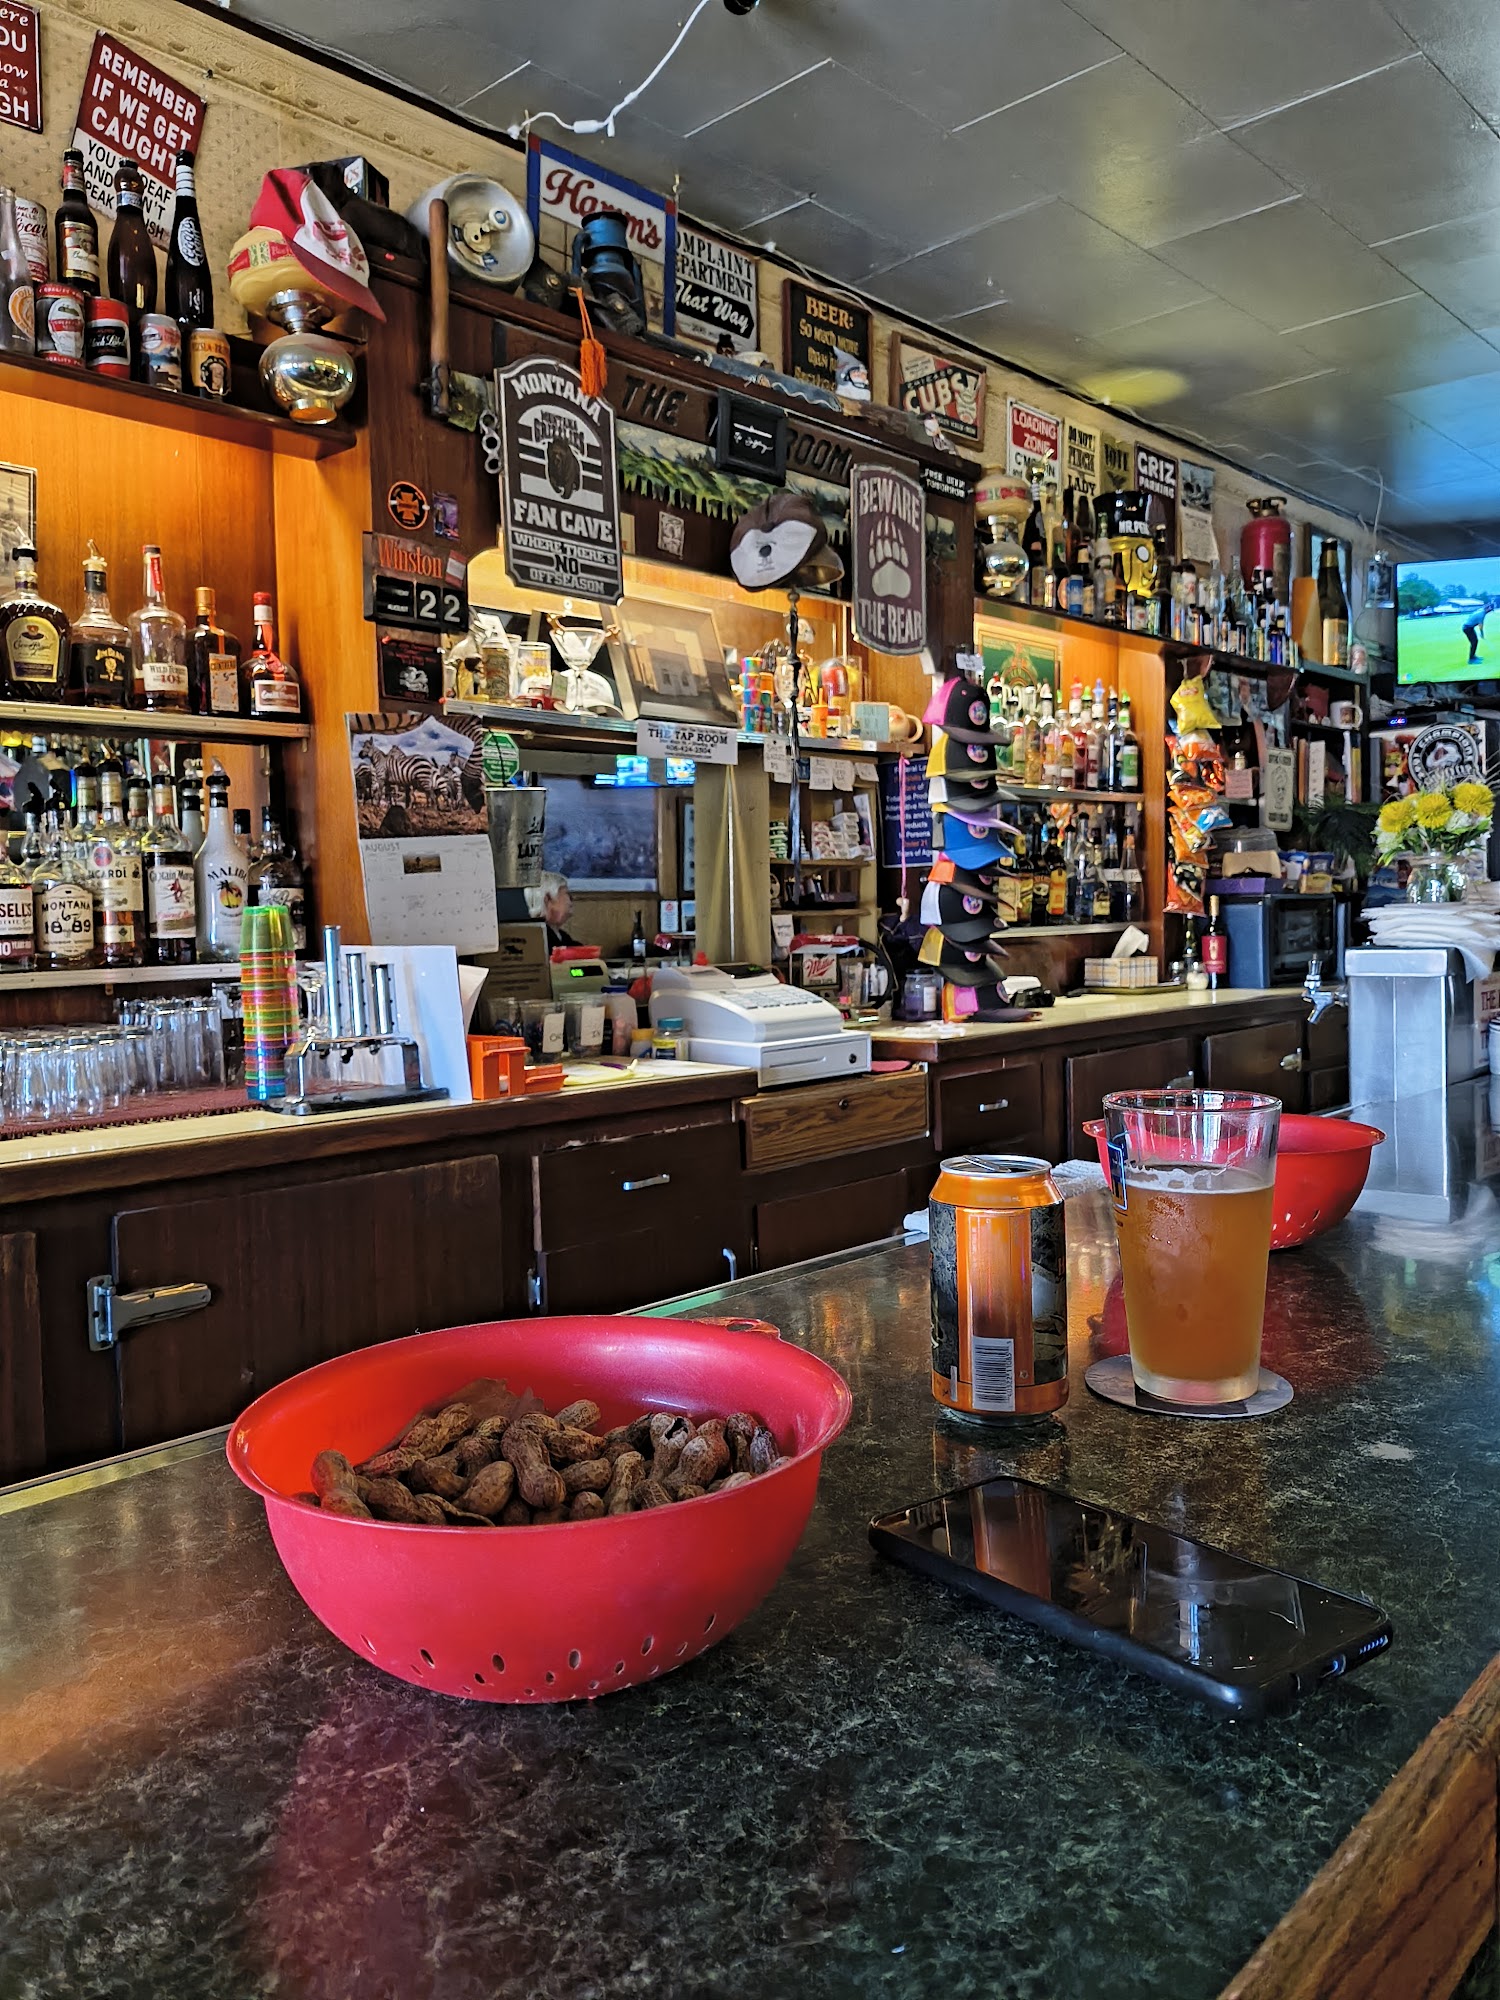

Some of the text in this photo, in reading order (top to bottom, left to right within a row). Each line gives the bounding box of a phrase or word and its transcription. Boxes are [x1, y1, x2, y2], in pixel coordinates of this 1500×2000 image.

[0, 61, 29, 79] ow
[99, 44, 198, 126] REMEMBER
[91, 73, 192, 151] IF WE GET
[91, 106, 177, 179] CAUGHT
[84, 160, 166, 219] AND N'T
[85, 180, 115, 210] PEAK
[677, 231, 752, 280] MPLAINT
[677, 254, 753, 302] PARTMENT
[676, 280, 710, 314] That
[712, 296, 749, 334] Way
[805, 294, 854, 330] BEER:
[510, 373, 601, 426] MONTANA
[621, 374, 688, 428] THE
[1013, 408, 1057, 441] LOADING
[1137, 451, 1177, 487] GRIZ
[513, 498, 614, 544] FAN CAVE
[858, 476, 921, 534] BEWARE
[377, 537, 443, 580] Winston
[513, 529, 616, 566] WHERE THERE'S
[554, 554, 580, 577] NO
[529, 567, 606, 595] OFFSEASON
[858, 598, 923, 644] THE BEAR
[648, 728, 672, 739] THE
[675, 731, 694, 742] TAP
[697, 734, 728, 745] ROOM
[364, 842, 400, 853] AUGUST
[41, 900, 91, 912] MONTANA
